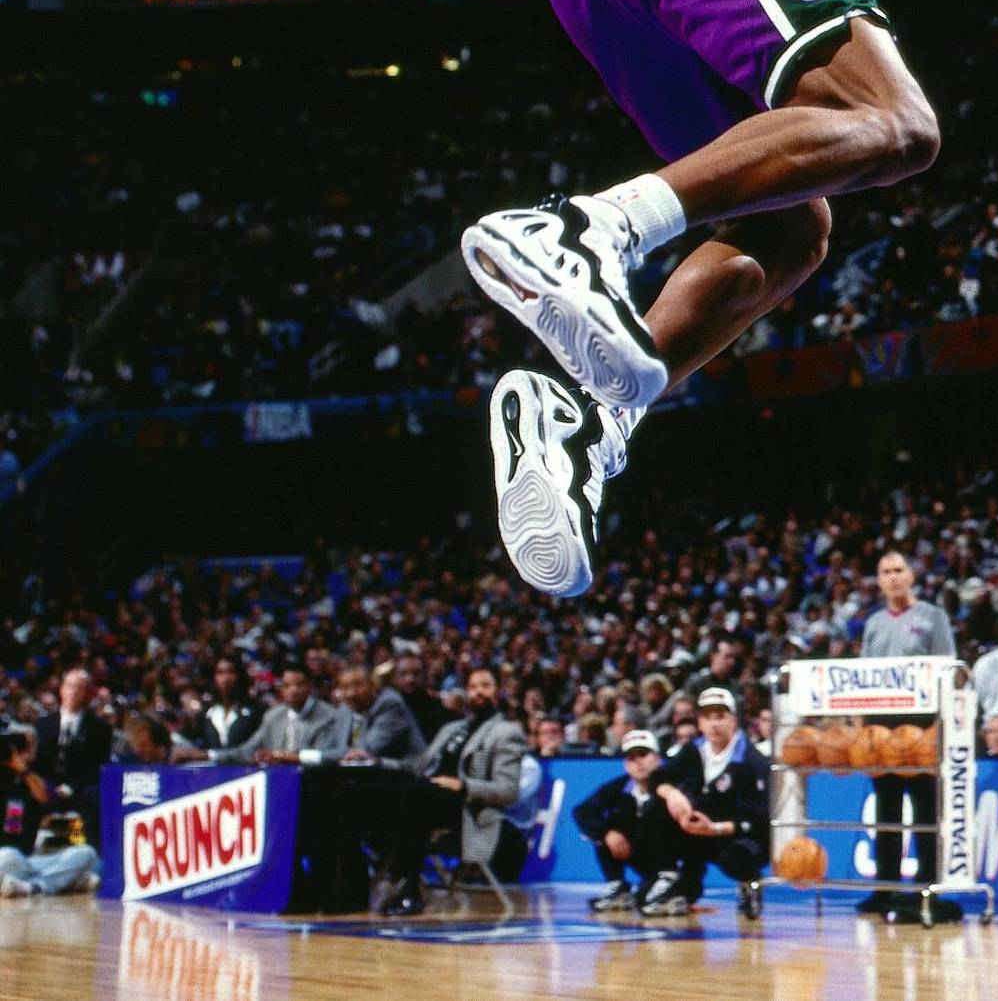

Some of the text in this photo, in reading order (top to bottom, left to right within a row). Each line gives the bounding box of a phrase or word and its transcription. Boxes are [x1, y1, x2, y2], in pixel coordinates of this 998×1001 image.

[828, 662, 915, 695] SPALDING
[134, 785, 256, 889] CRUNCH
[948, 746, 969, 876] SPALDING
